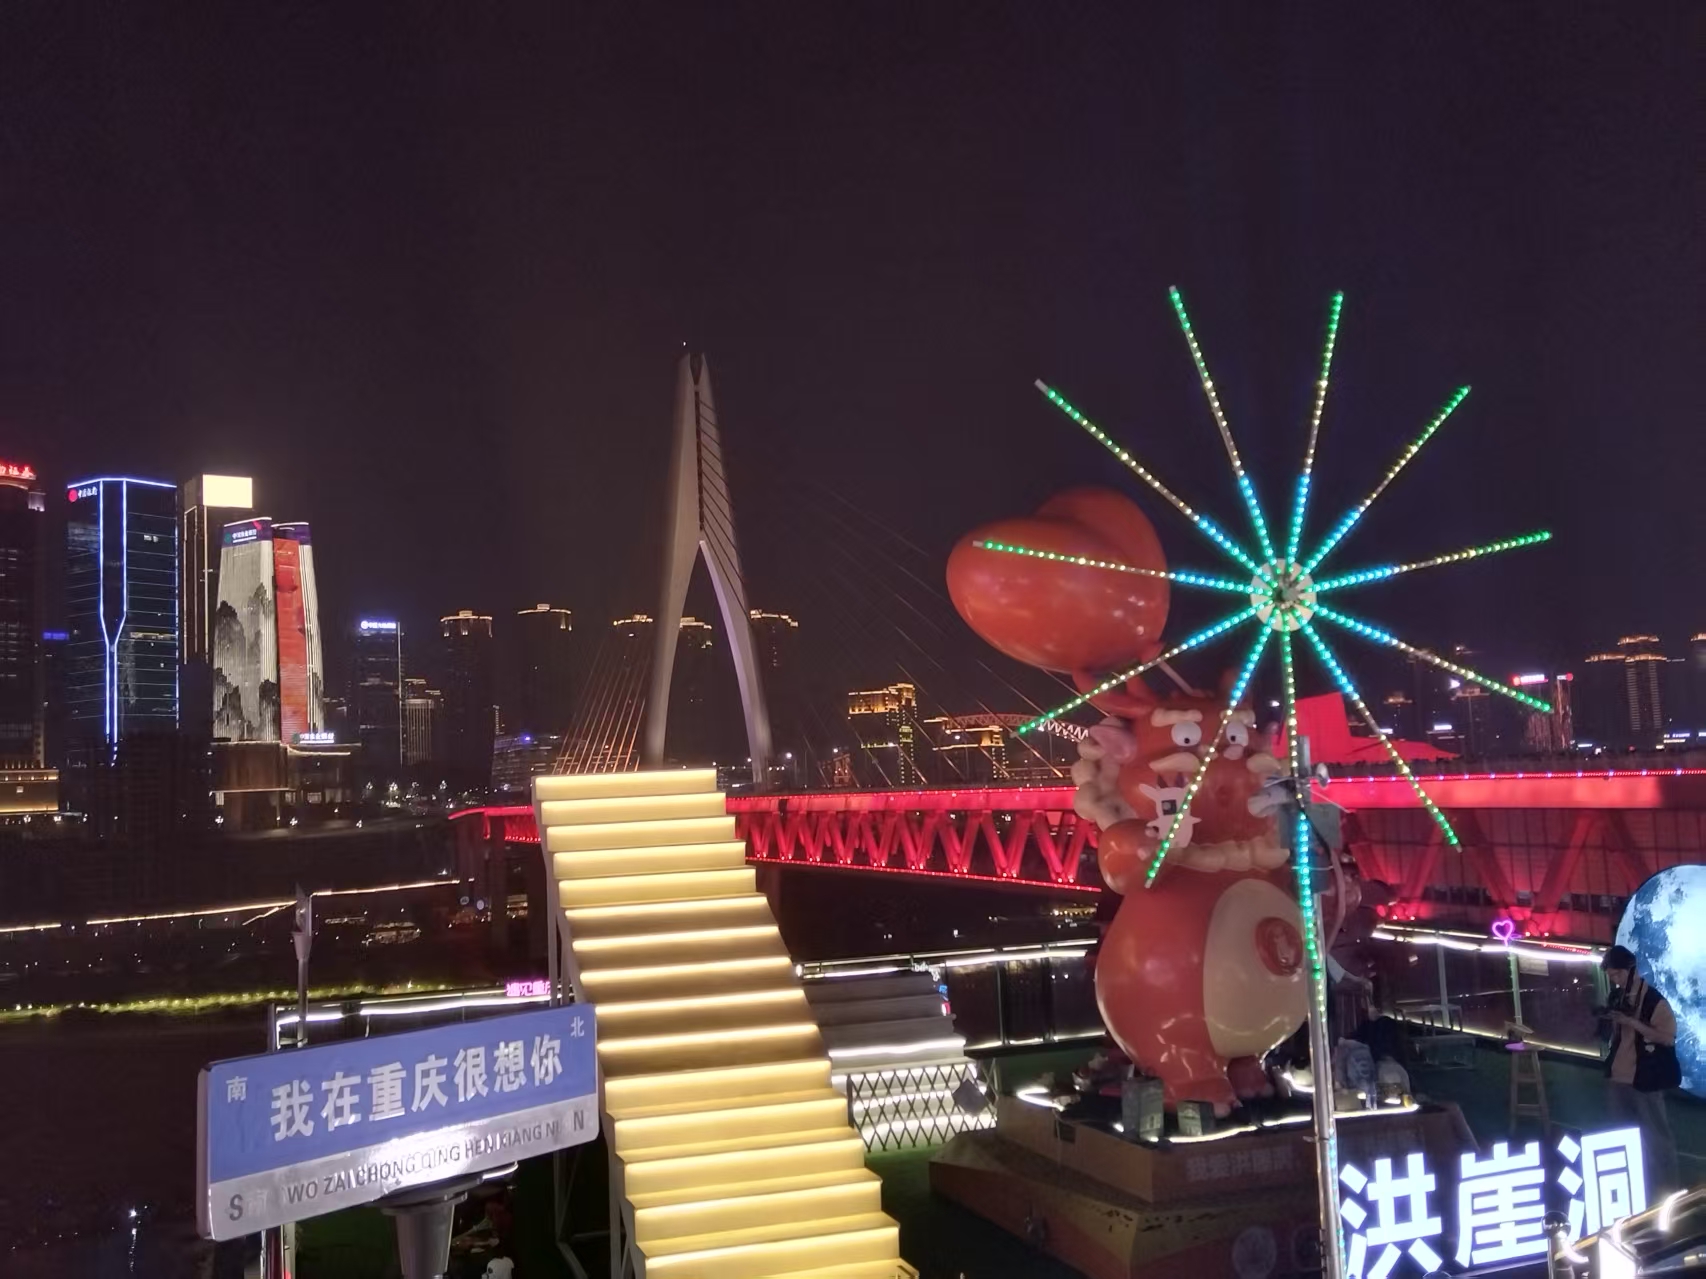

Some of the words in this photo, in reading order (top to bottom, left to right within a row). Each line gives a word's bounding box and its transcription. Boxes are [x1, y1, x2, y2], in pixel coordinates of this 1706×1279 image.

[570, 1016, 585, 1038] 北
[226, 1075, 247, 1103] 南
[270, 1034, 563, 1142] 我在重庆很想你
[573, 1109, 584, 1131] N
[288, 1180, 318, 1204] WO
[324, 1168, 350, 1196] ZAI
[465, 1136, 494, 1160] HEN
[229, 1194, 243, 1221] S
[1339, 1127, 1646, 1279] 洪崖洞
